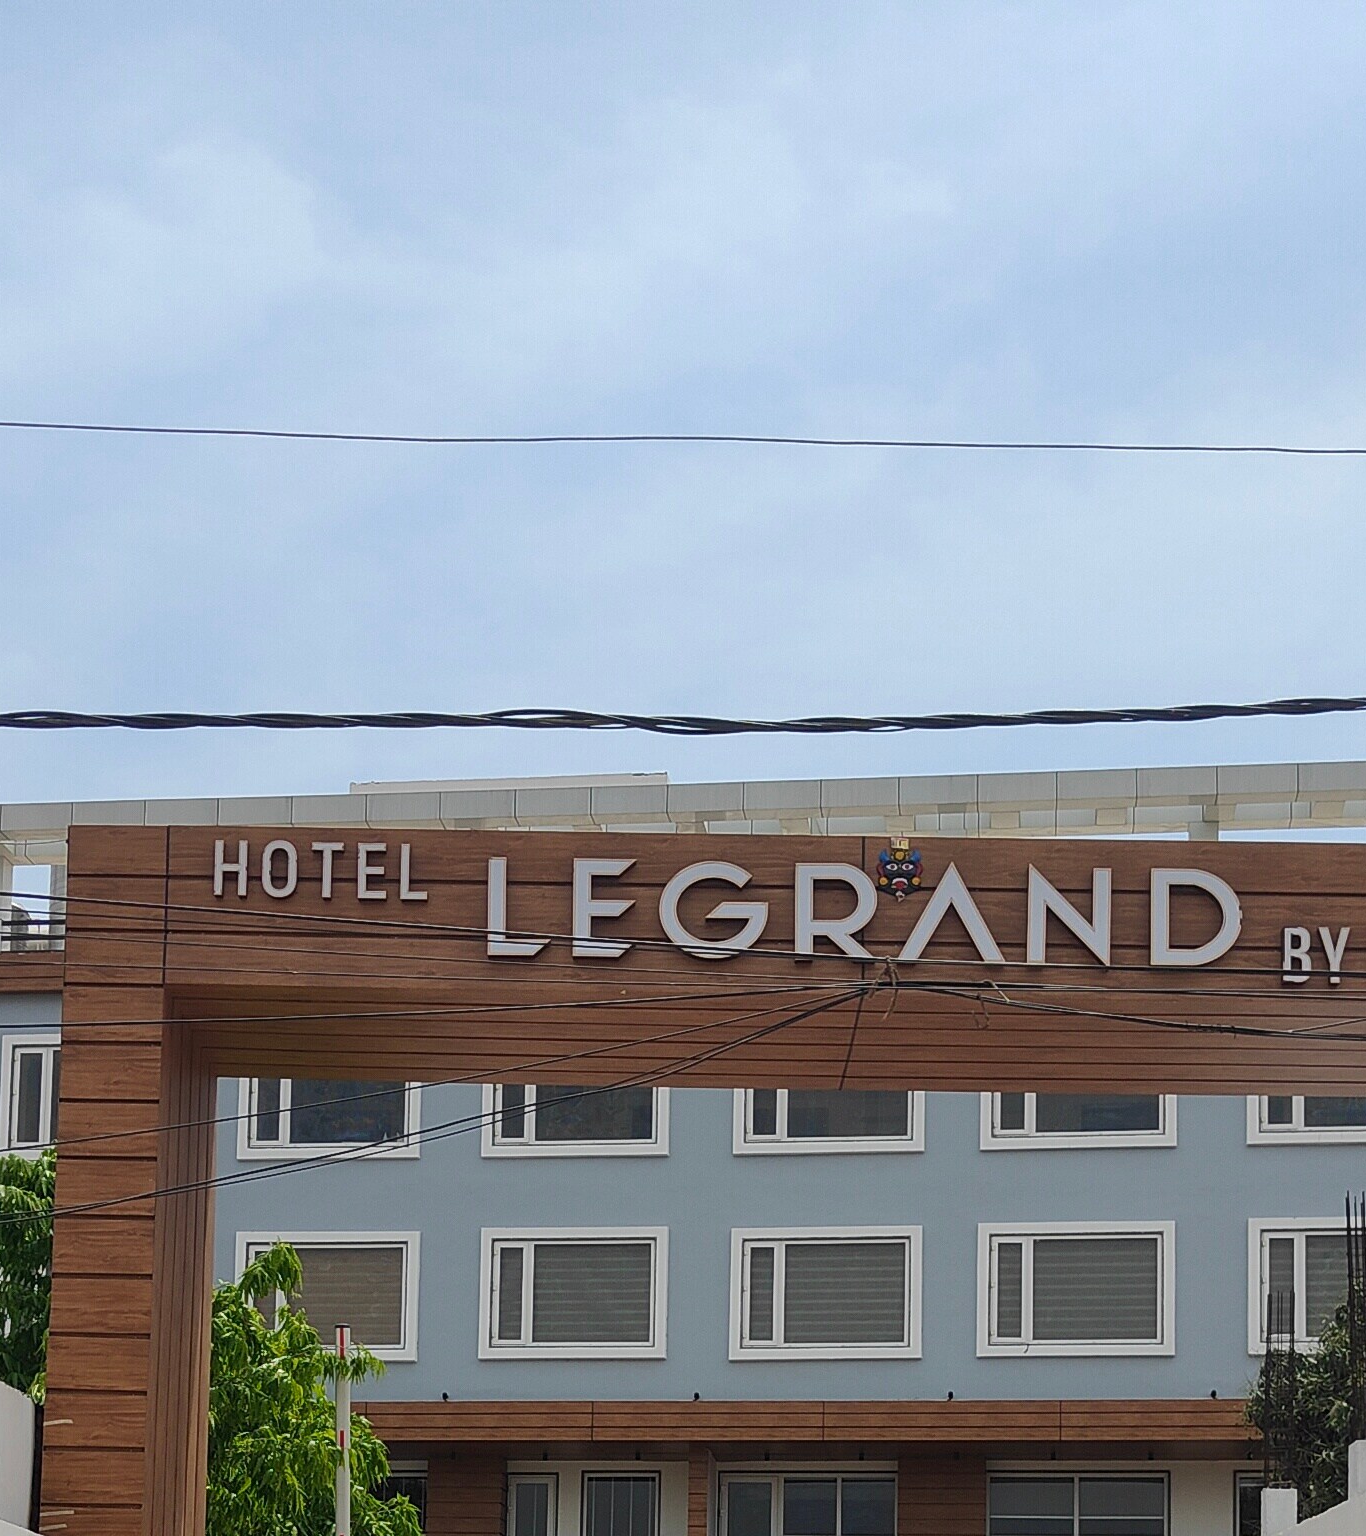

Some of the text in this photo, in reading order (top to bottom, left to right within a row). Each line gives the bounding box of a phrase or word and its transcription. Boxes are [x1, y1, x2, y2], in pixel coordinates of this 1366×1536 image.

[212, 838, 429, 901] HOTEL
[486, 855, 1241, 968] LEGRAND
[1282, 926, 1351, 985] BY
